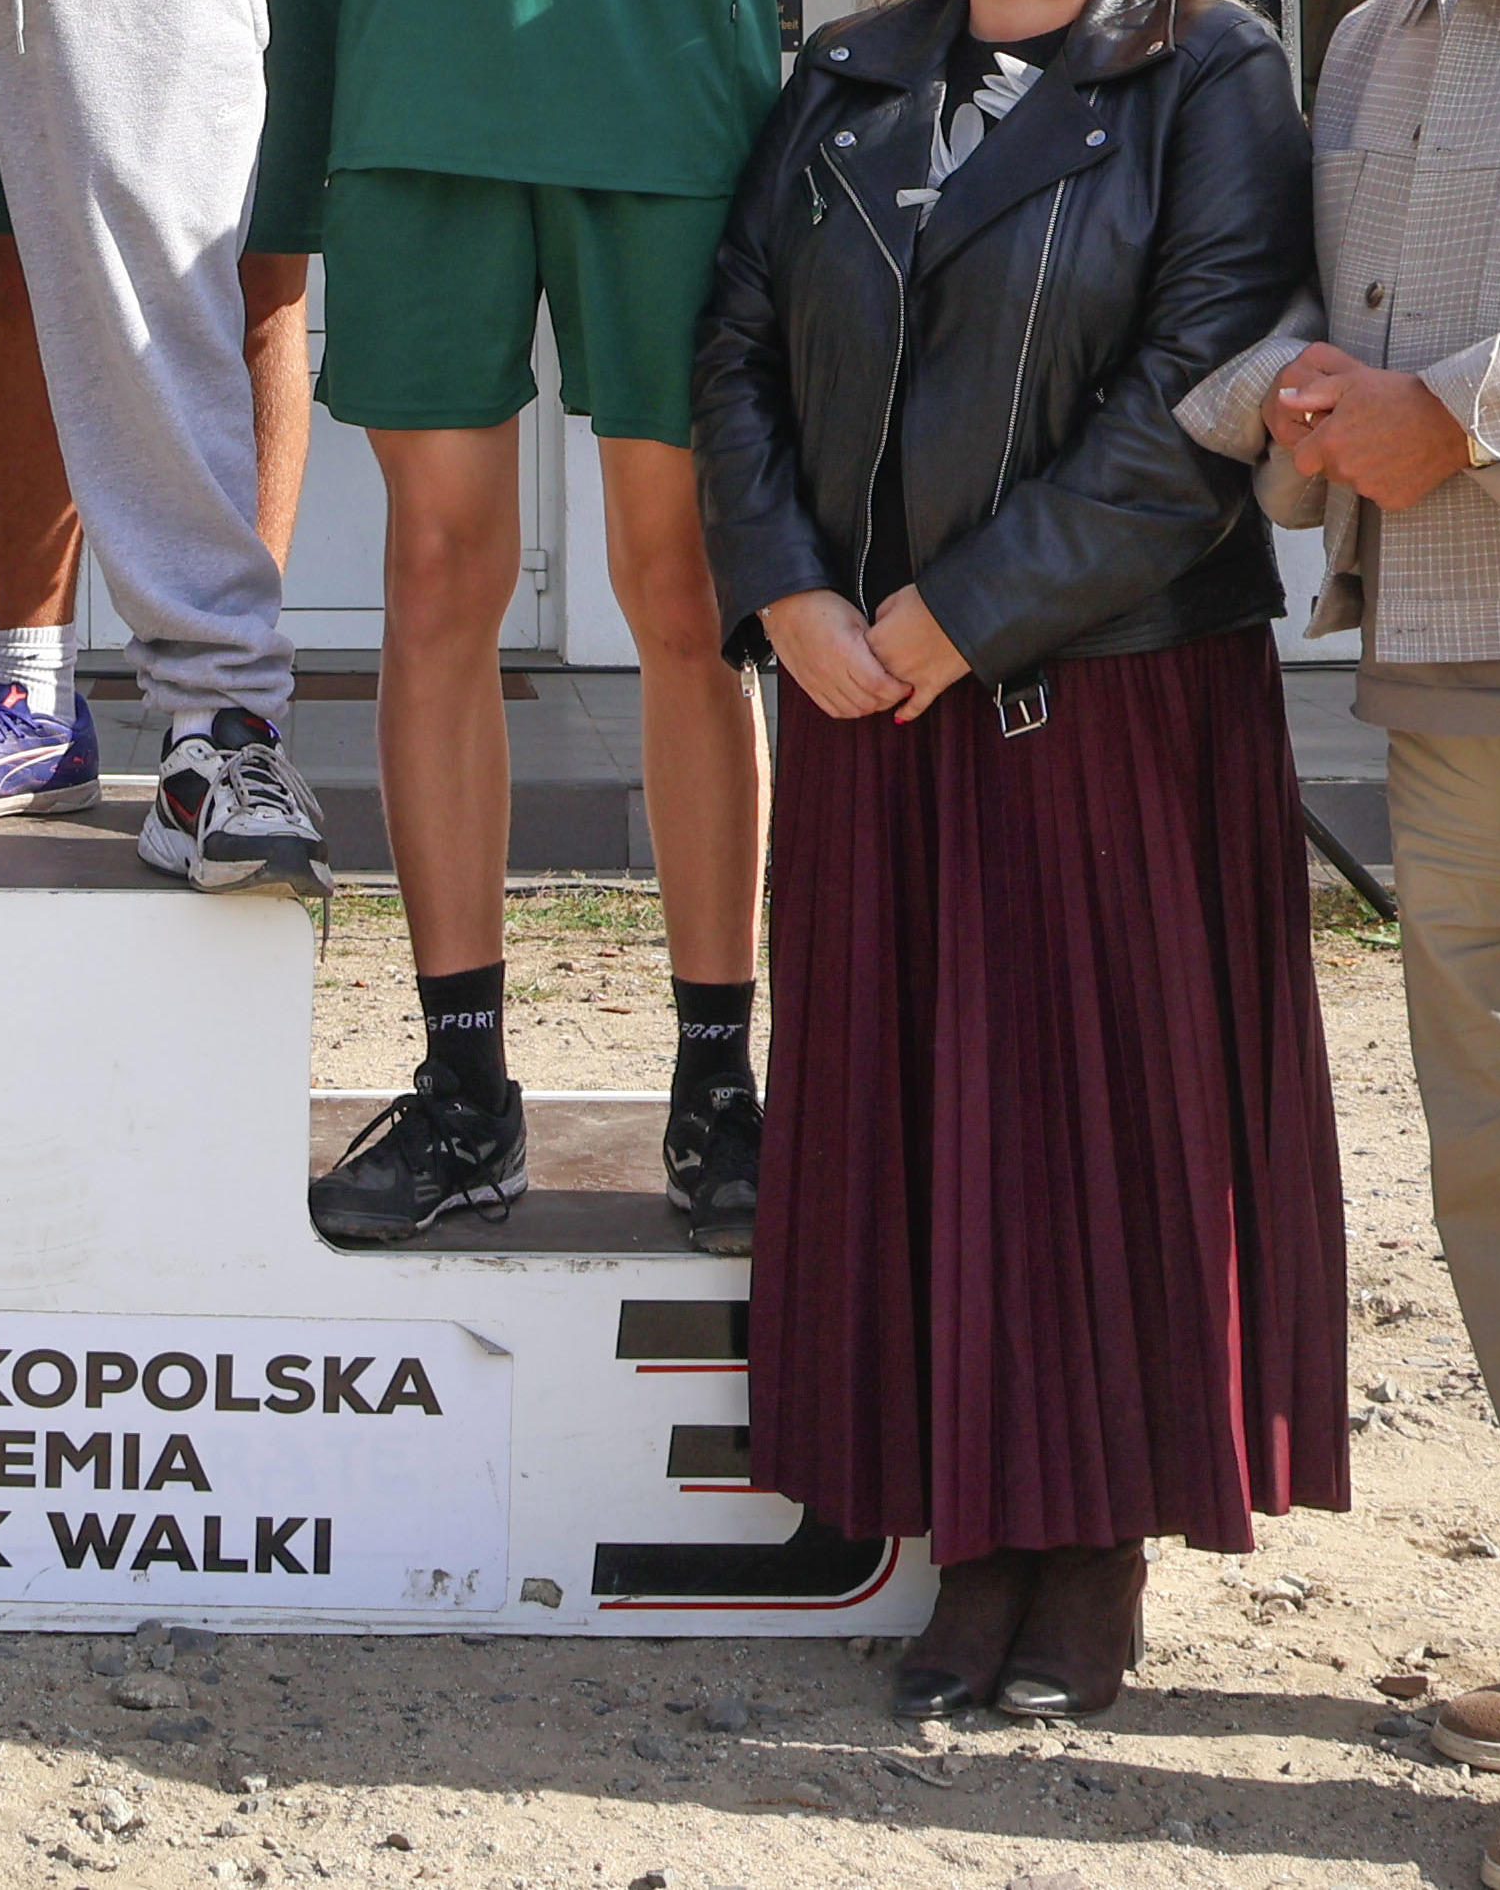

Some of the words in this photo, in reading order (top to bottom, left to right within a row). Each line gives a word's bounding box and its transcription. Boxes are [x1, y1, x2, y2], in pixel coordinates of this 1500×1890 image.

[428, 1010, 496, 1032] SPORT
[680, 1022, 746, 1041] PORT
[46, 1510, 332, 1575] WALKI
